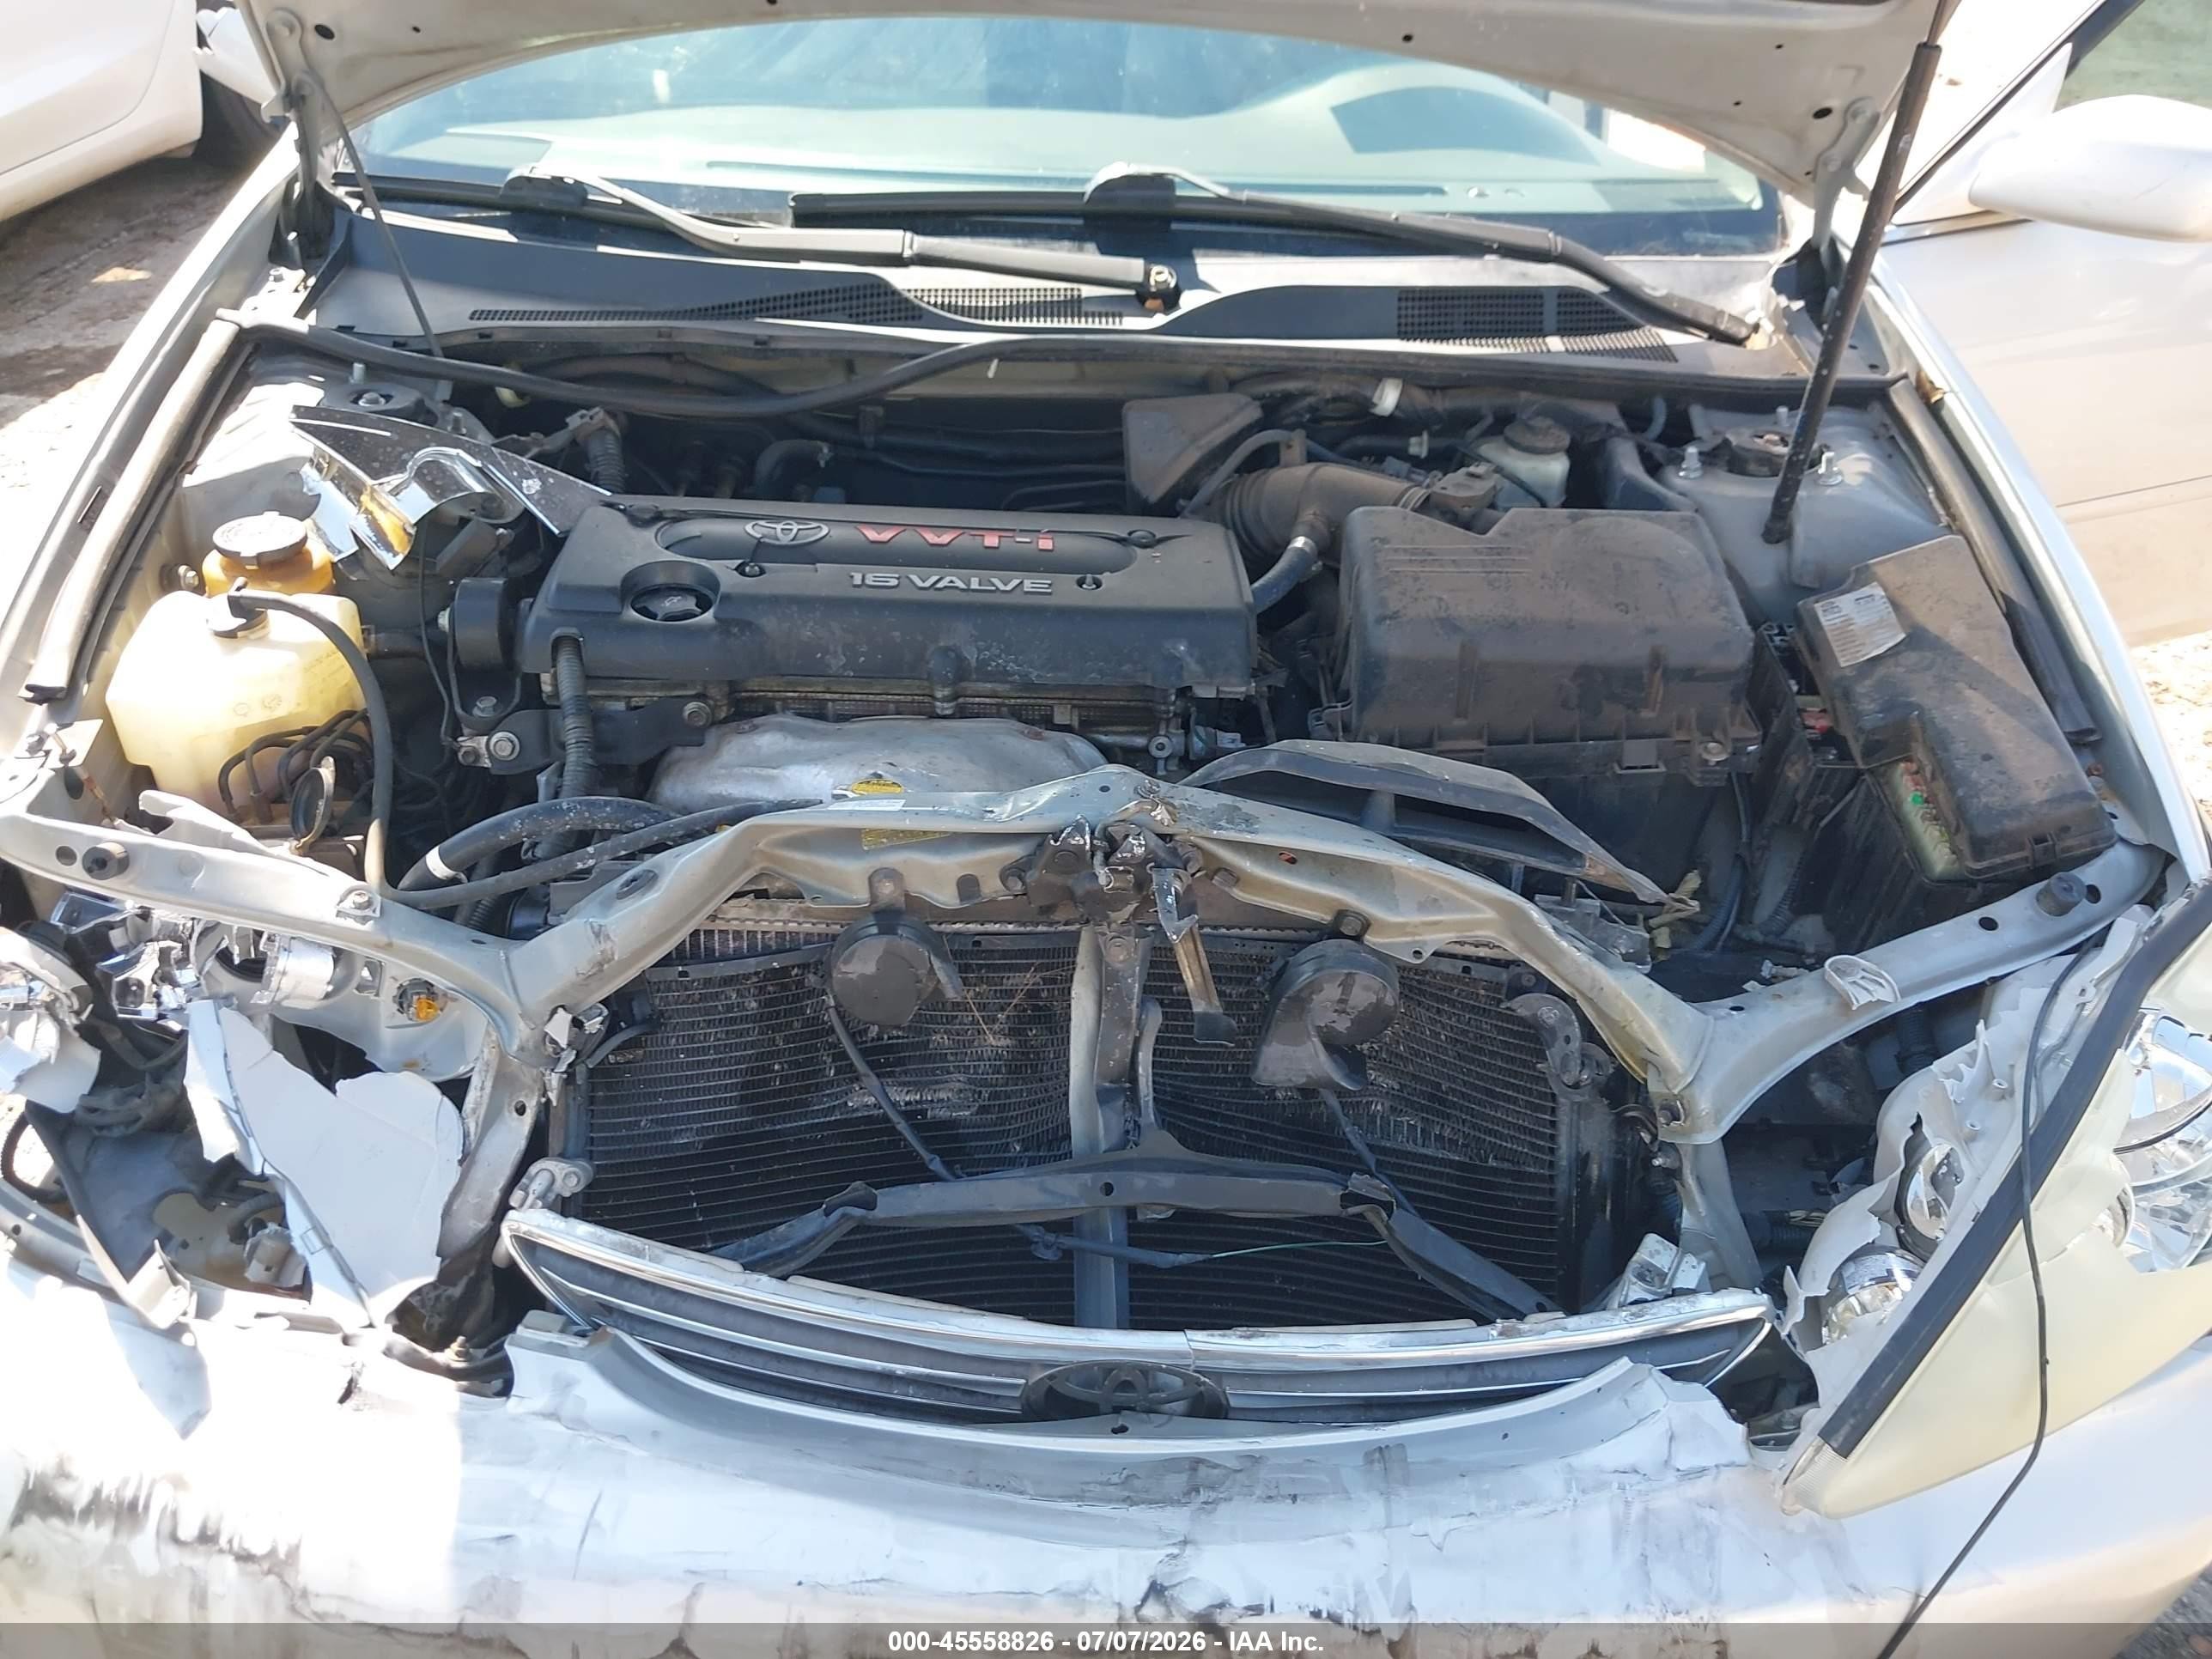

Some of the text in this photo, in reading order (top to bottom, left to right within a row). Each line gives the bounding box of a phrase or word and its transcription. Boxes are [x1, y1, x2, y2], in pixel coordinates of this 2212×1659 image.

[855, 525, 1054, 550] VVT-i
[849, 572, 1053, 594] 16 VALVE
